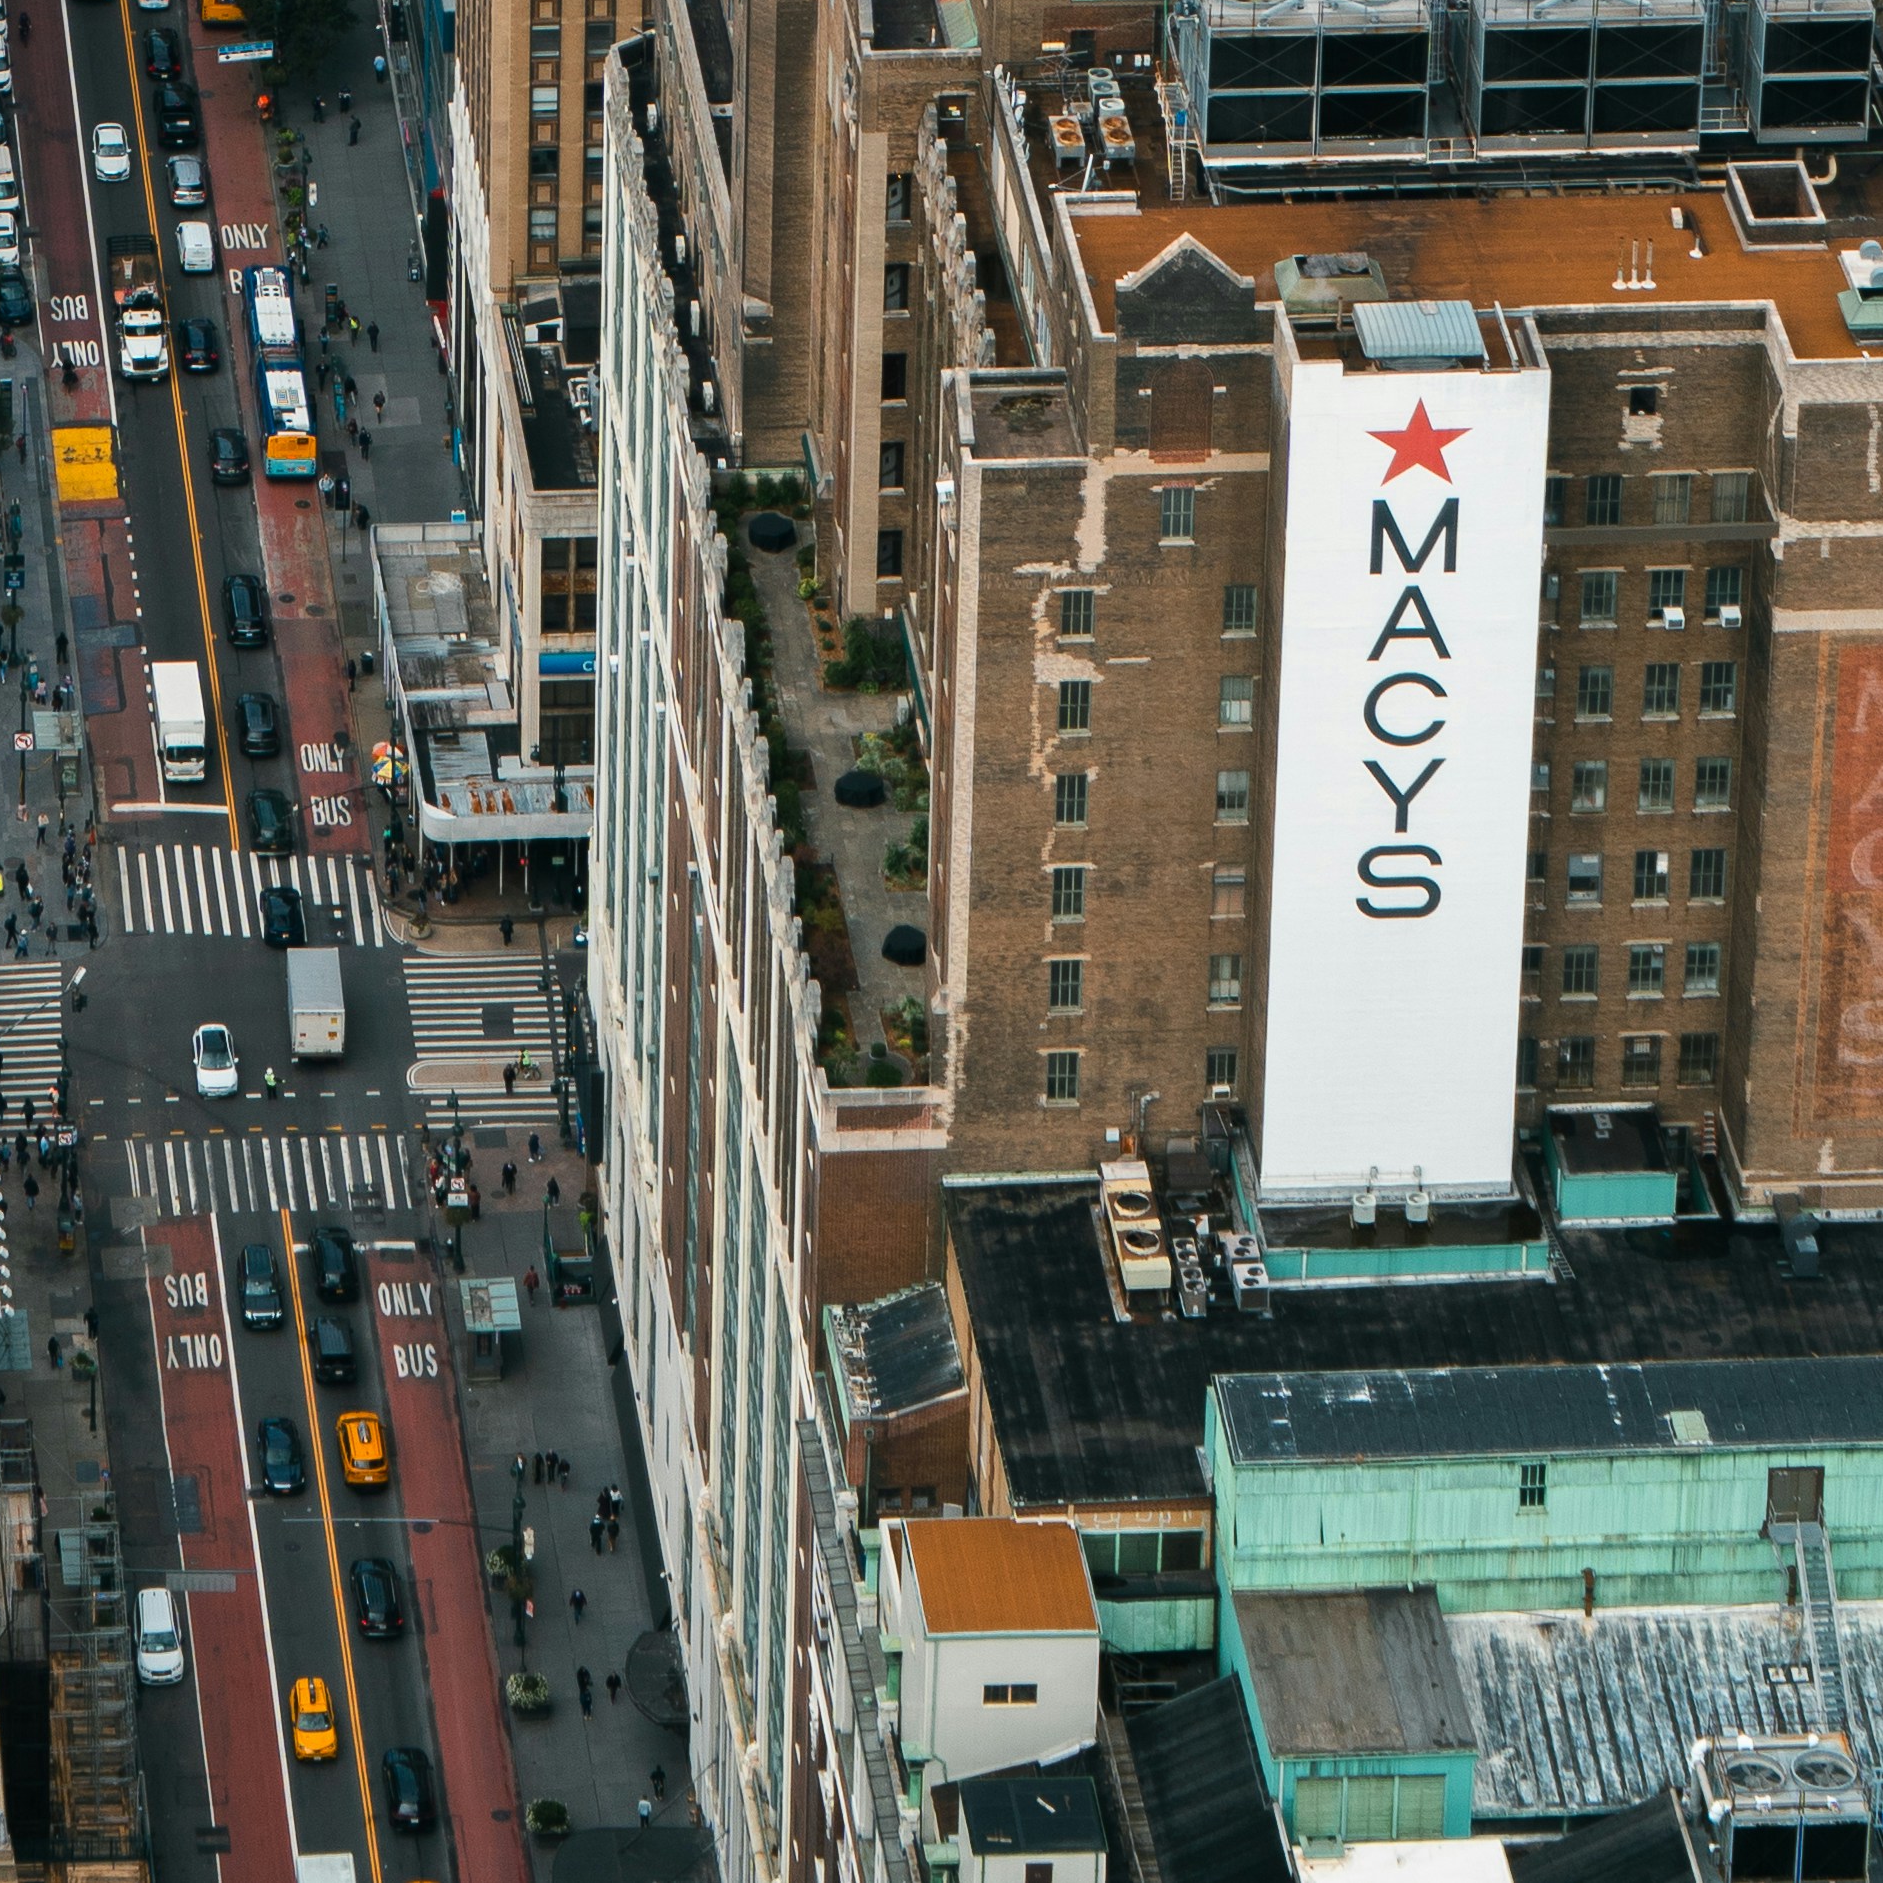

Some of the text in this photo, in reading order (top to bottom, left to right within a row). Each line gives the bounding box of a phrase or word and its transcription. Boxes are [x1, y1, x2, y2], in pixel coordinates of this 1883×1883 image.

[221, 223, 269, 250] ONLY
[50, 295, 89, 322] BUS
[50, 339, 100, 368] ONLY
[1356, 497, 1460, 918] MACYS
[300, 742, 345, 773] ONLY
[310, 795, 352, 827] BUS
[164, 1272, 209, 1308] BUS
[378, 1282, 432, 1317] ONLY
[166, 1333, 222, 1369] ONLY
[393, 1343, 438, 1378] BUS
